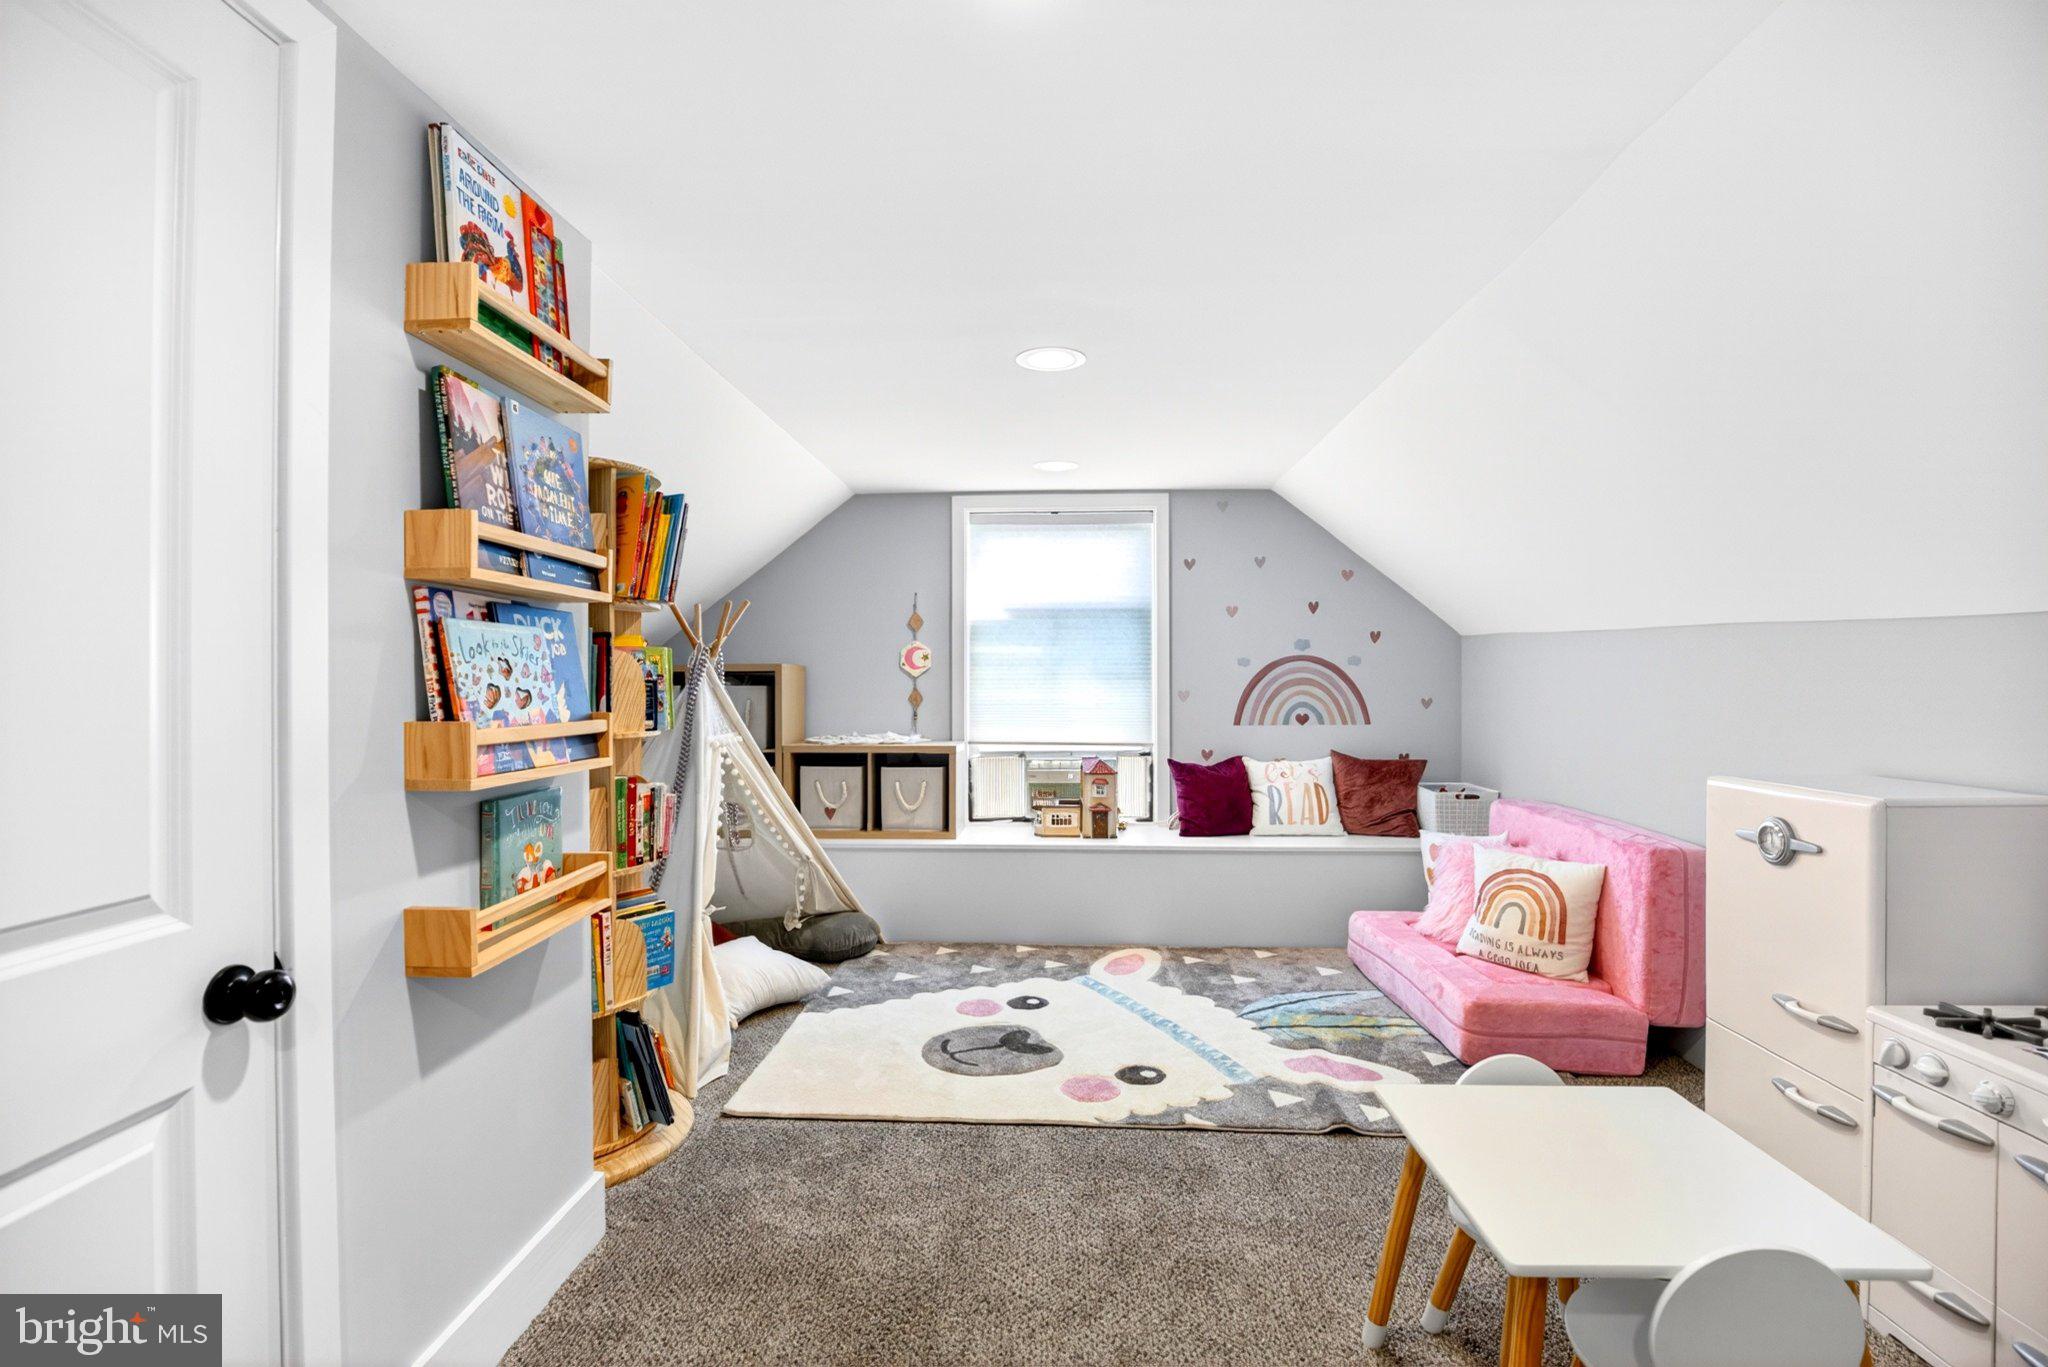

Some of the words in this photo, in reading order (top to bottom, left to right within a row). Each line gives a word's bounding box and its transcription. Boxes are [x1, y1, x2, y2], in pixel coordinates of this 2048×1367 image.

[459, 167, 500, 213] AROUND
[456, 186, 476, 216] THE
[477, 205, 504, 239] FARM
[458, 632, 490, 665] Look
[511, 633, 541, 667] Skies
[1478, 949, 1484, 958] A
[1504, 938, 1514, 953] IS
[1517, 945, 1564, 961] ALWAYS
